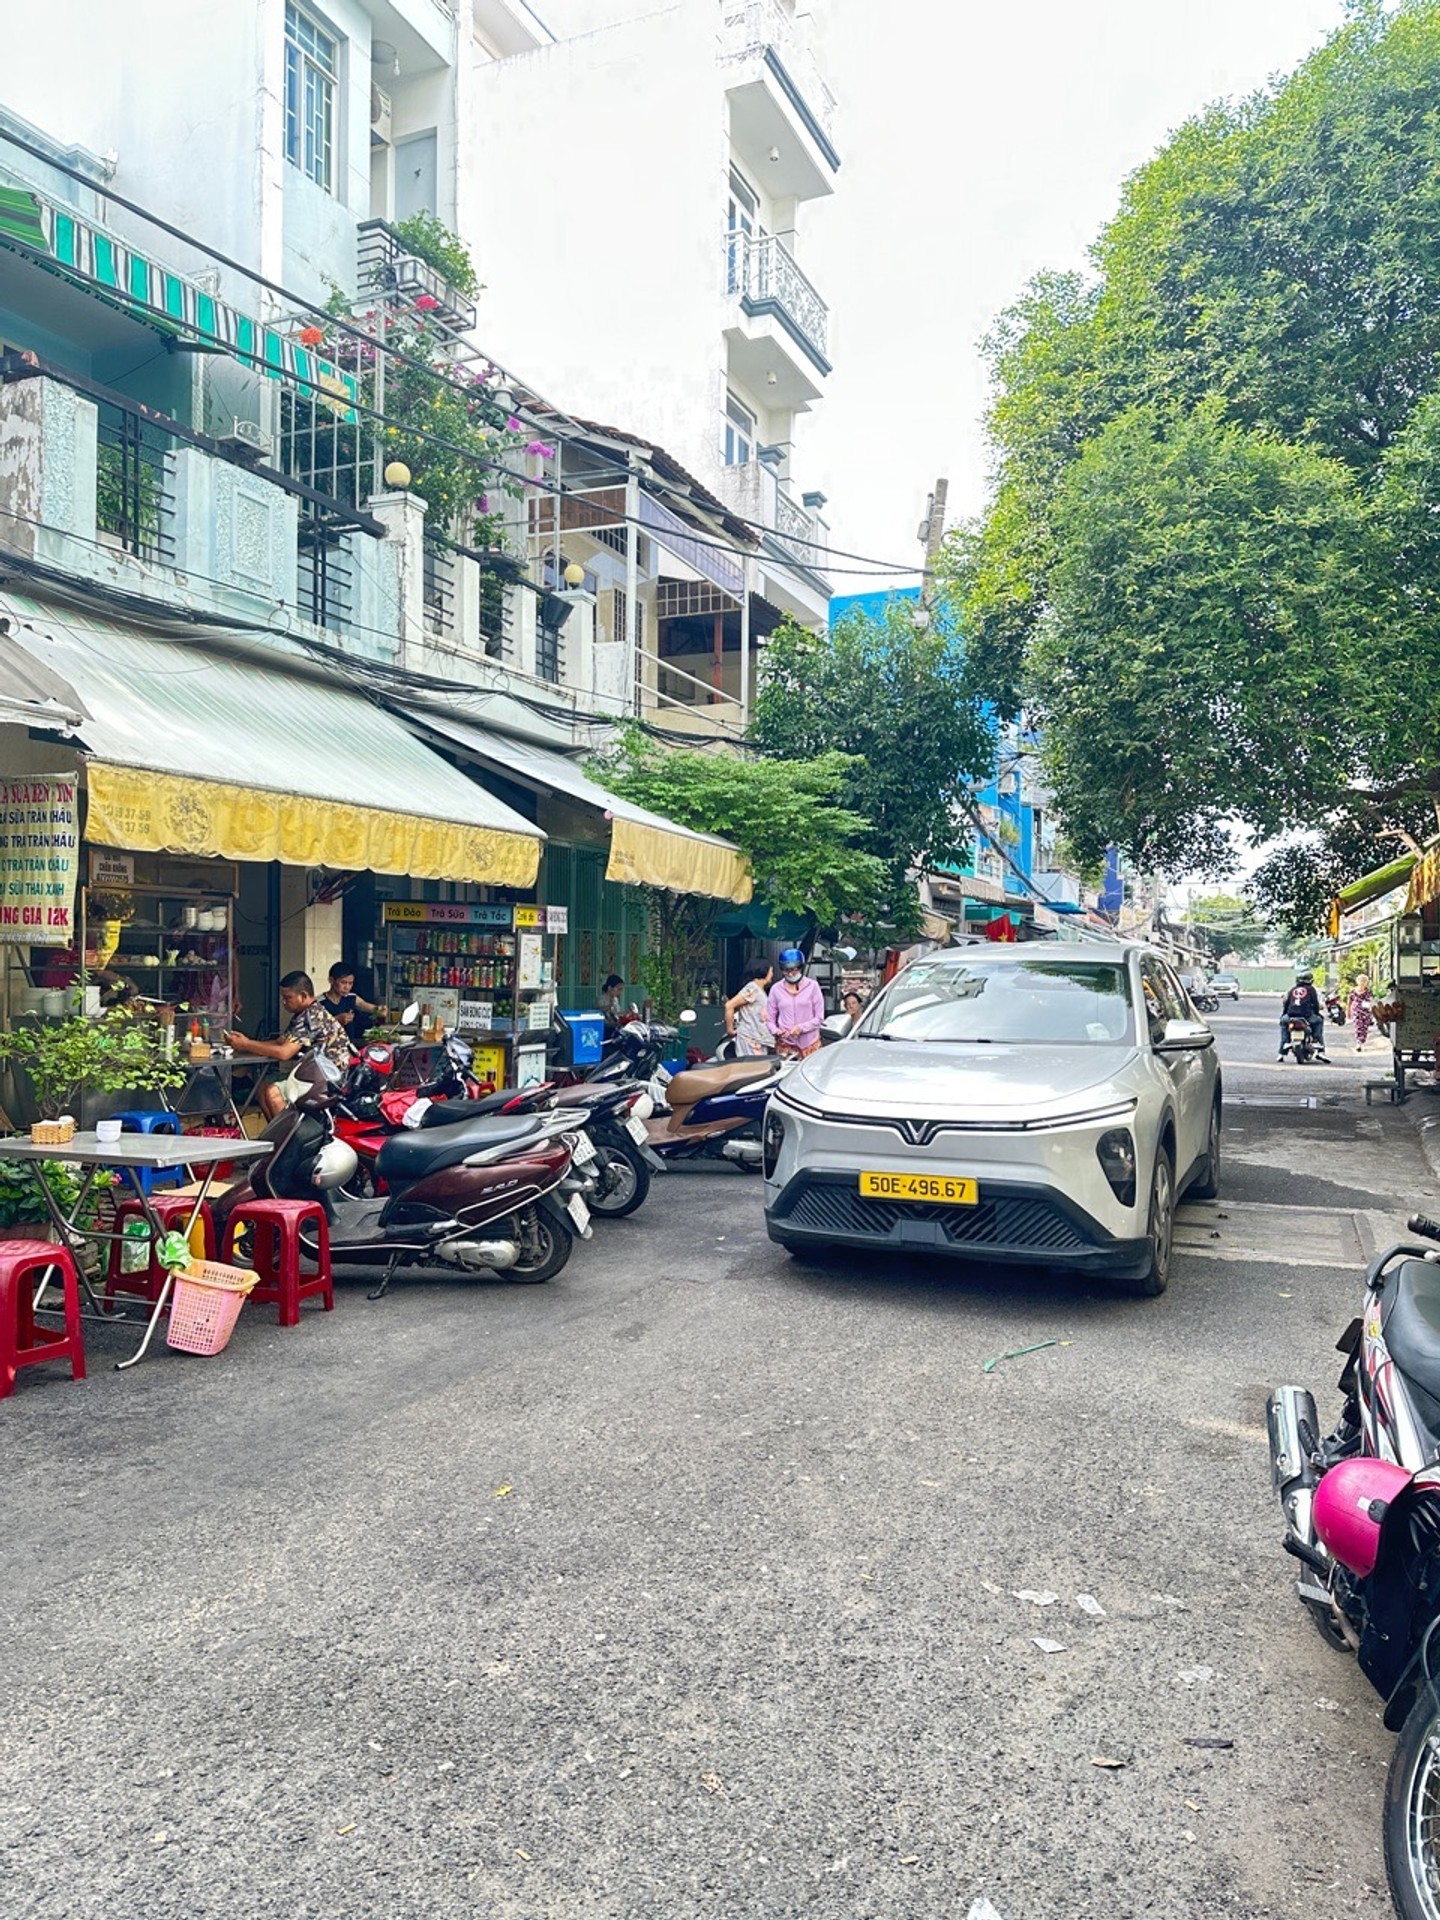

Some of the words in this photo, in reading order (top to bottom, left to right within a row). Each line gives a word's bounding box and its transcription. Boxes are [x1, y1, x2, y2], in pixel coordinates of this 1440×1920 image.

[23, 902, 42, 925] GIÁ
[47, 907, 69, 926] 12K
[870, 1176, 966, 1198] 50E-496.67
